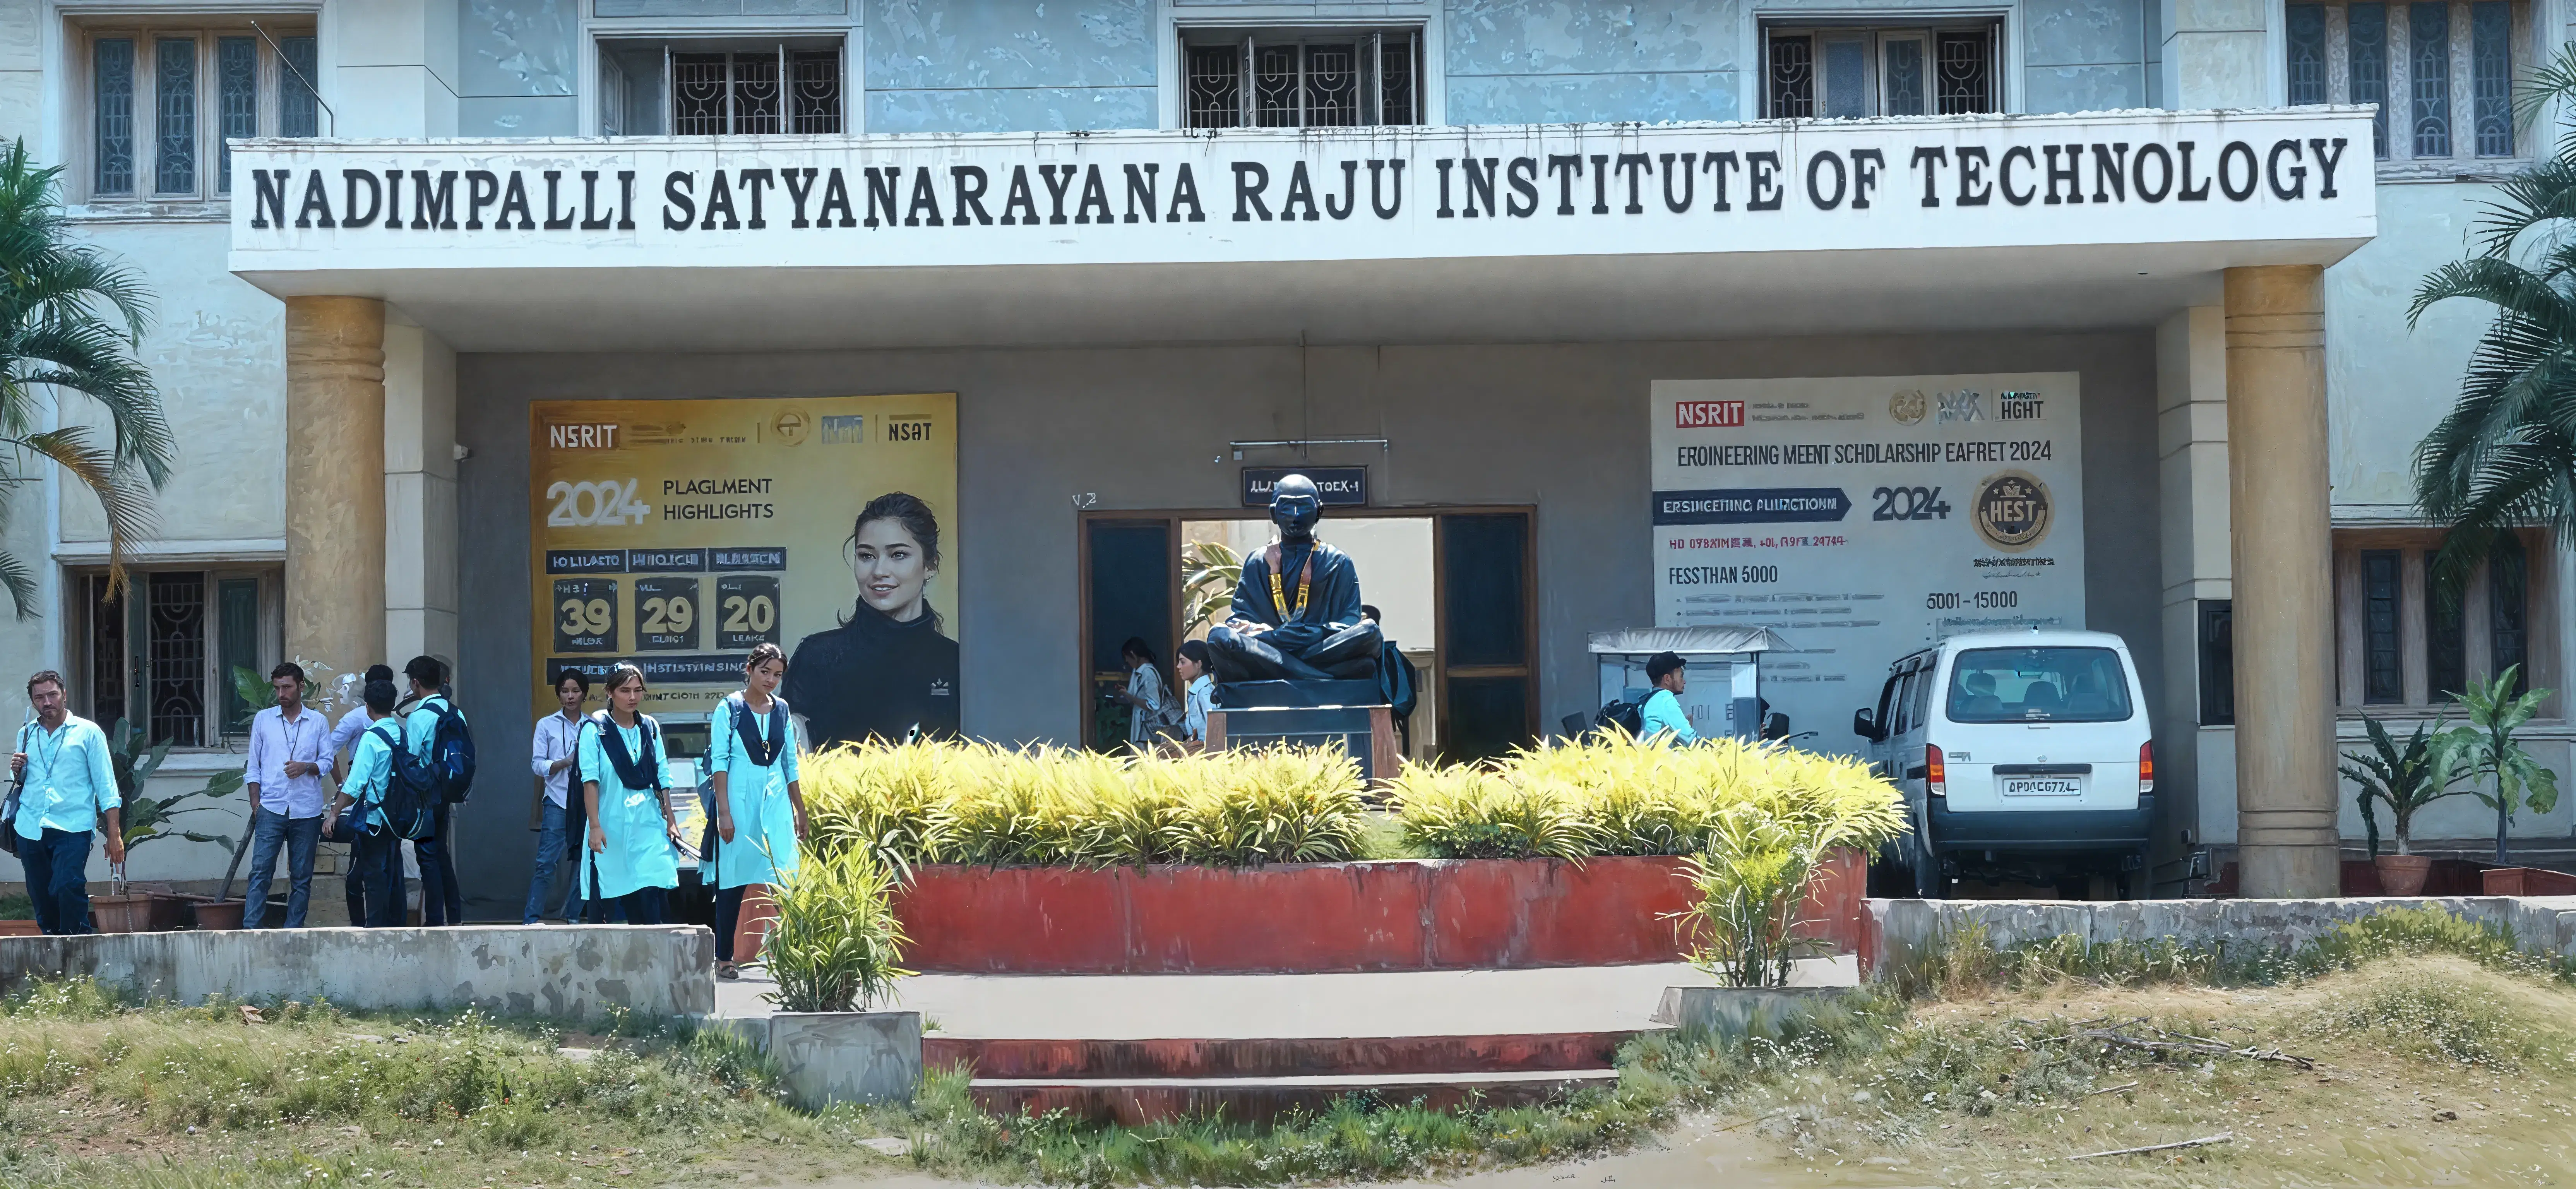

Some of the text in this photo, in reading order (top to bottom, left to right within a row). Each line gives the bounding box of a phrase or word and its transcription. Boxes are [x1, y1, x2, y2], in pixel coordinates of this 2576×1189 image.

[250, 138, 2348, 233] NADIMPALLI SATYANARAYANA RAJU INSTITUTE OF TECHNOLOGY
[1679, 403, 1742, 425] NSRIT
[2001, 401, 2044, 420] HGHT
[550, 425, 617, 448] NSRIT
[889, 422, 932, 441] NSAT
[1783, 444, 1831, 465] MEENT
[1946, 441, 2007, 462] EAFRET
[2010, 440, 2051, 461] 2024
[663, 478, 772, 495] PLAGLMENT
[547, 478, 651, 527] 2024
[664, 503, 774, 521] HIGHLIGHTS
[1872, 486, 1951, 521] 2024
[1990, 500, 2036, 522] HEST
[1742, 565, 1778, 583] 5000
[1973, 591, 2018, 608] 15000
[642, 596, 693, 634] 29
[724, 595, 774, 632] 20
